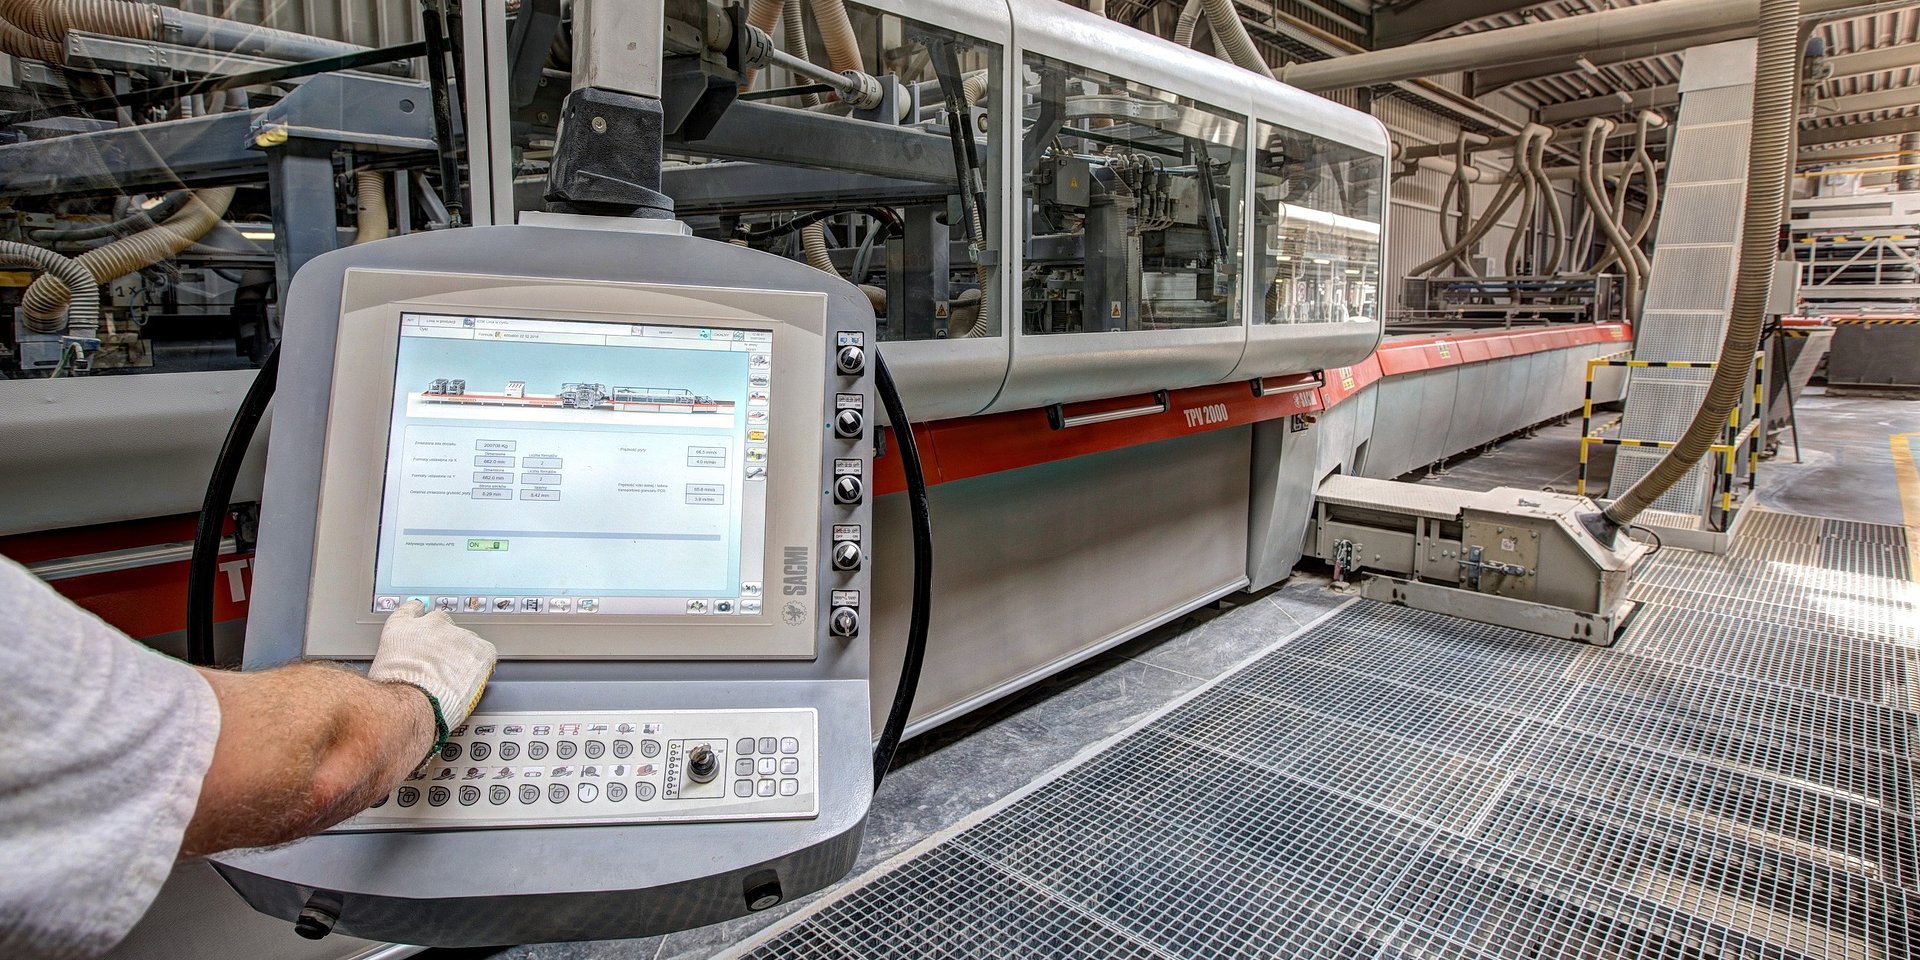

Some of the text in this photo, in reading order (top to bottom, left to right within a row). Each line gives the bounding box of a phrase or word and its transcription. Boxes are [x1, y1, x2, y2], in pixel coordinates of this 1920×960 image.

[1183, 403, 1229, 428] TPV 2000
[783, 546, 808, 596] SACMI
